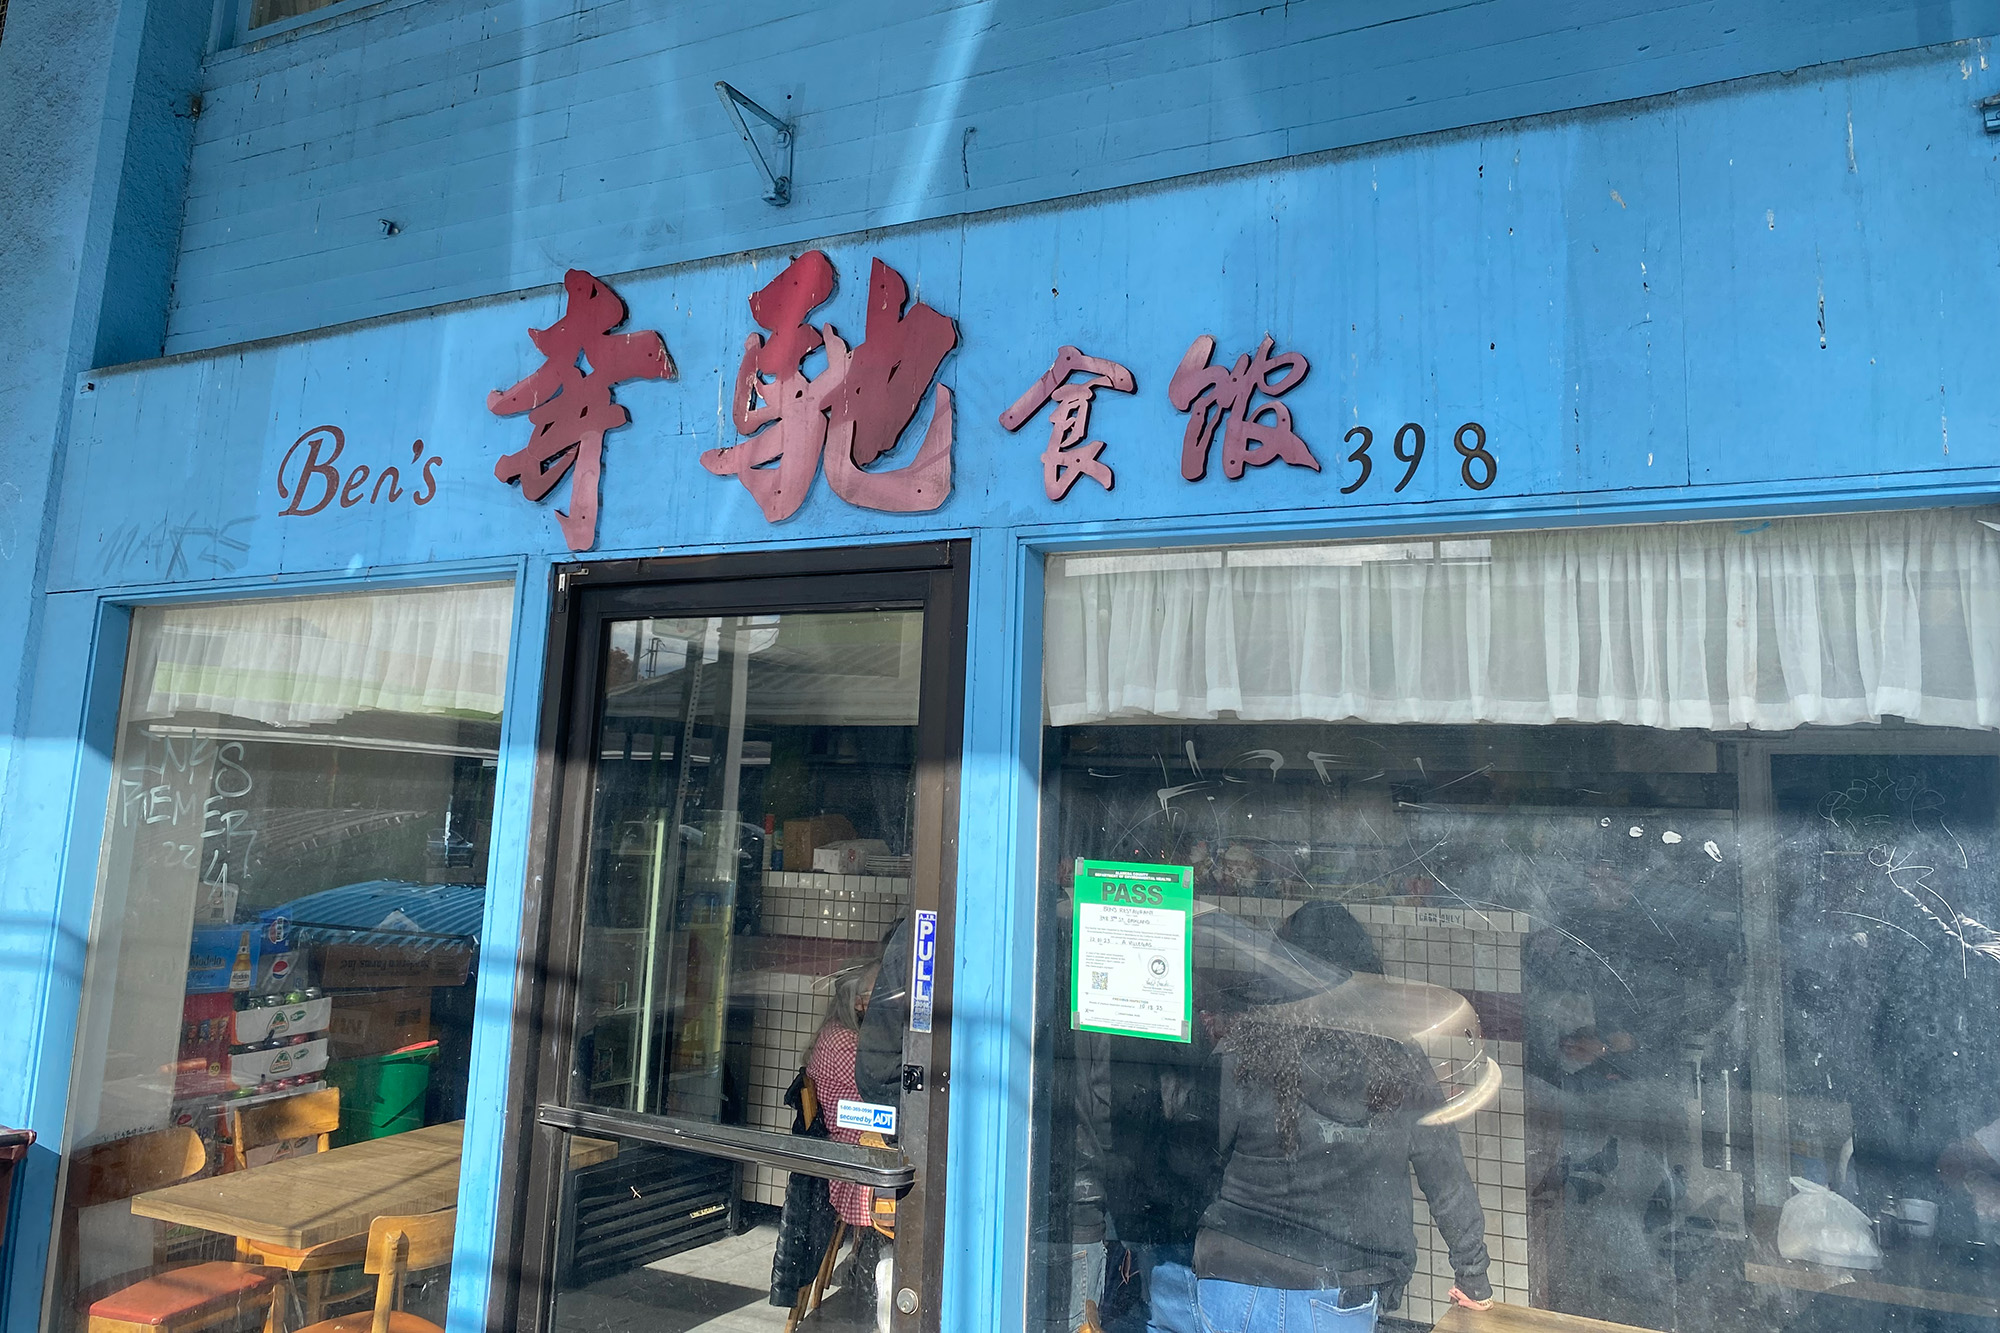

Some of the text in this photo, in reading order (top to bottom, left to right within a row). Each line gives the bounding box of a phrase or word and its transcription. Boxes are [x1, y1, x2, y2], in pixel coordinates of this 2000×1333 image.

[276, 424, 443, 518] Ben's
[1339, 421, 1498, 495] 398
[1101, 881, 1164, 905] PASS
[917, 920, 934, 1001] PULL
[839, 1113, 873, 1125] secured by
[873, 1111, 893, 1127] ADT
